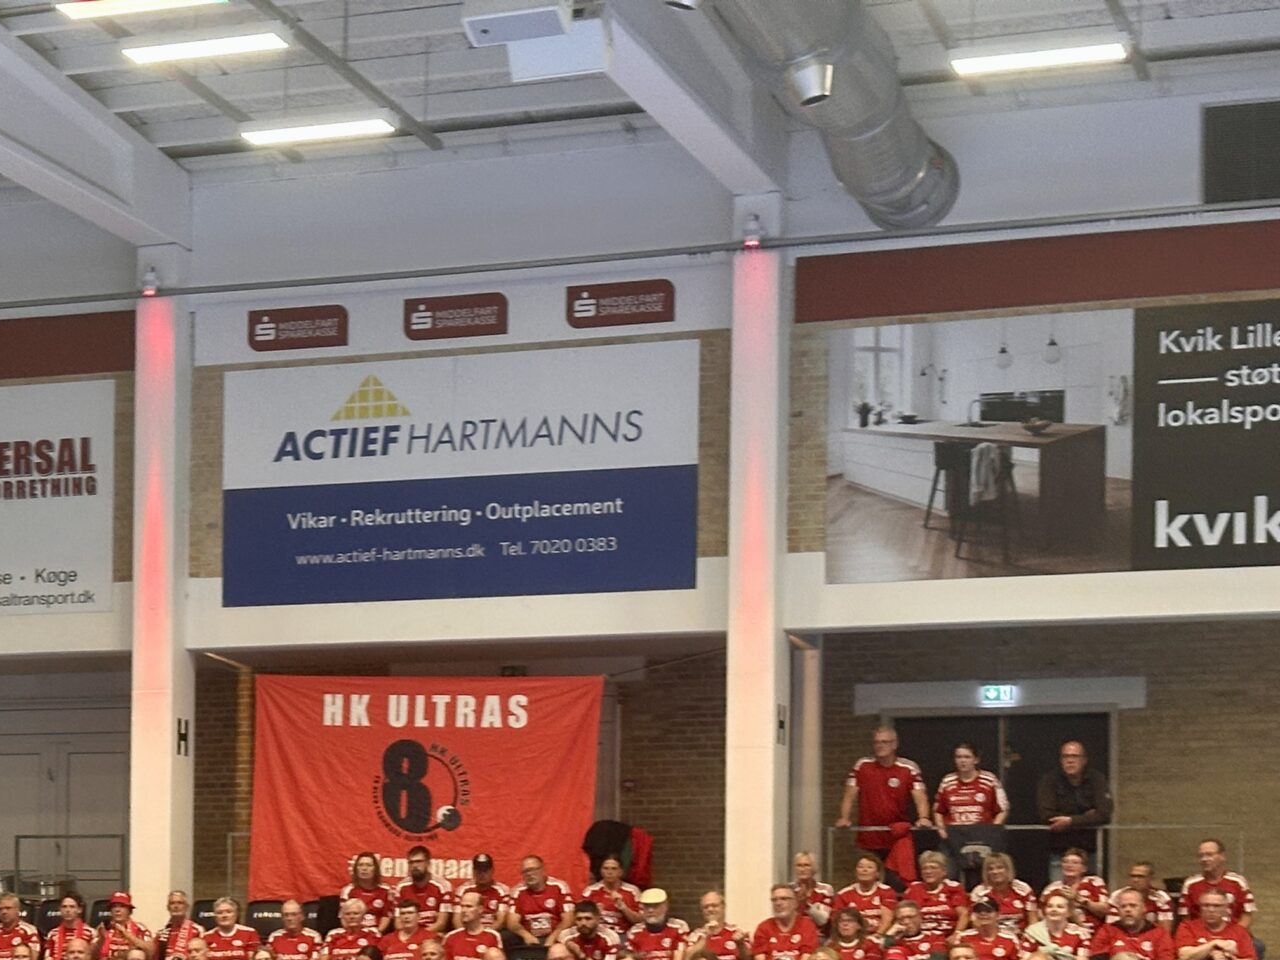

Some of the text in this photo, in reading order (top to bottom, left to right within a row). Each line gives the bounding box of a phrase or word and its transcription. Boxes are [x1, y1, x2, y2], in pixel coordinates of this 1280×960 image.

[1158, 327, 1223, 354] Kvik
[273, 410, 644, 462] ACTIEF HARTMANNS
[287, 498, 624, 530] Vikar Rekruttering Outplacement
[1154, 495, 1280, 548] kvik
[295, 537, 618, 566] www.actief-hartmanns.dk Tel. 7020 0383
[35, 568, 78, 587] Køge
[323, 693, 529, 728] HK ULTRAS
